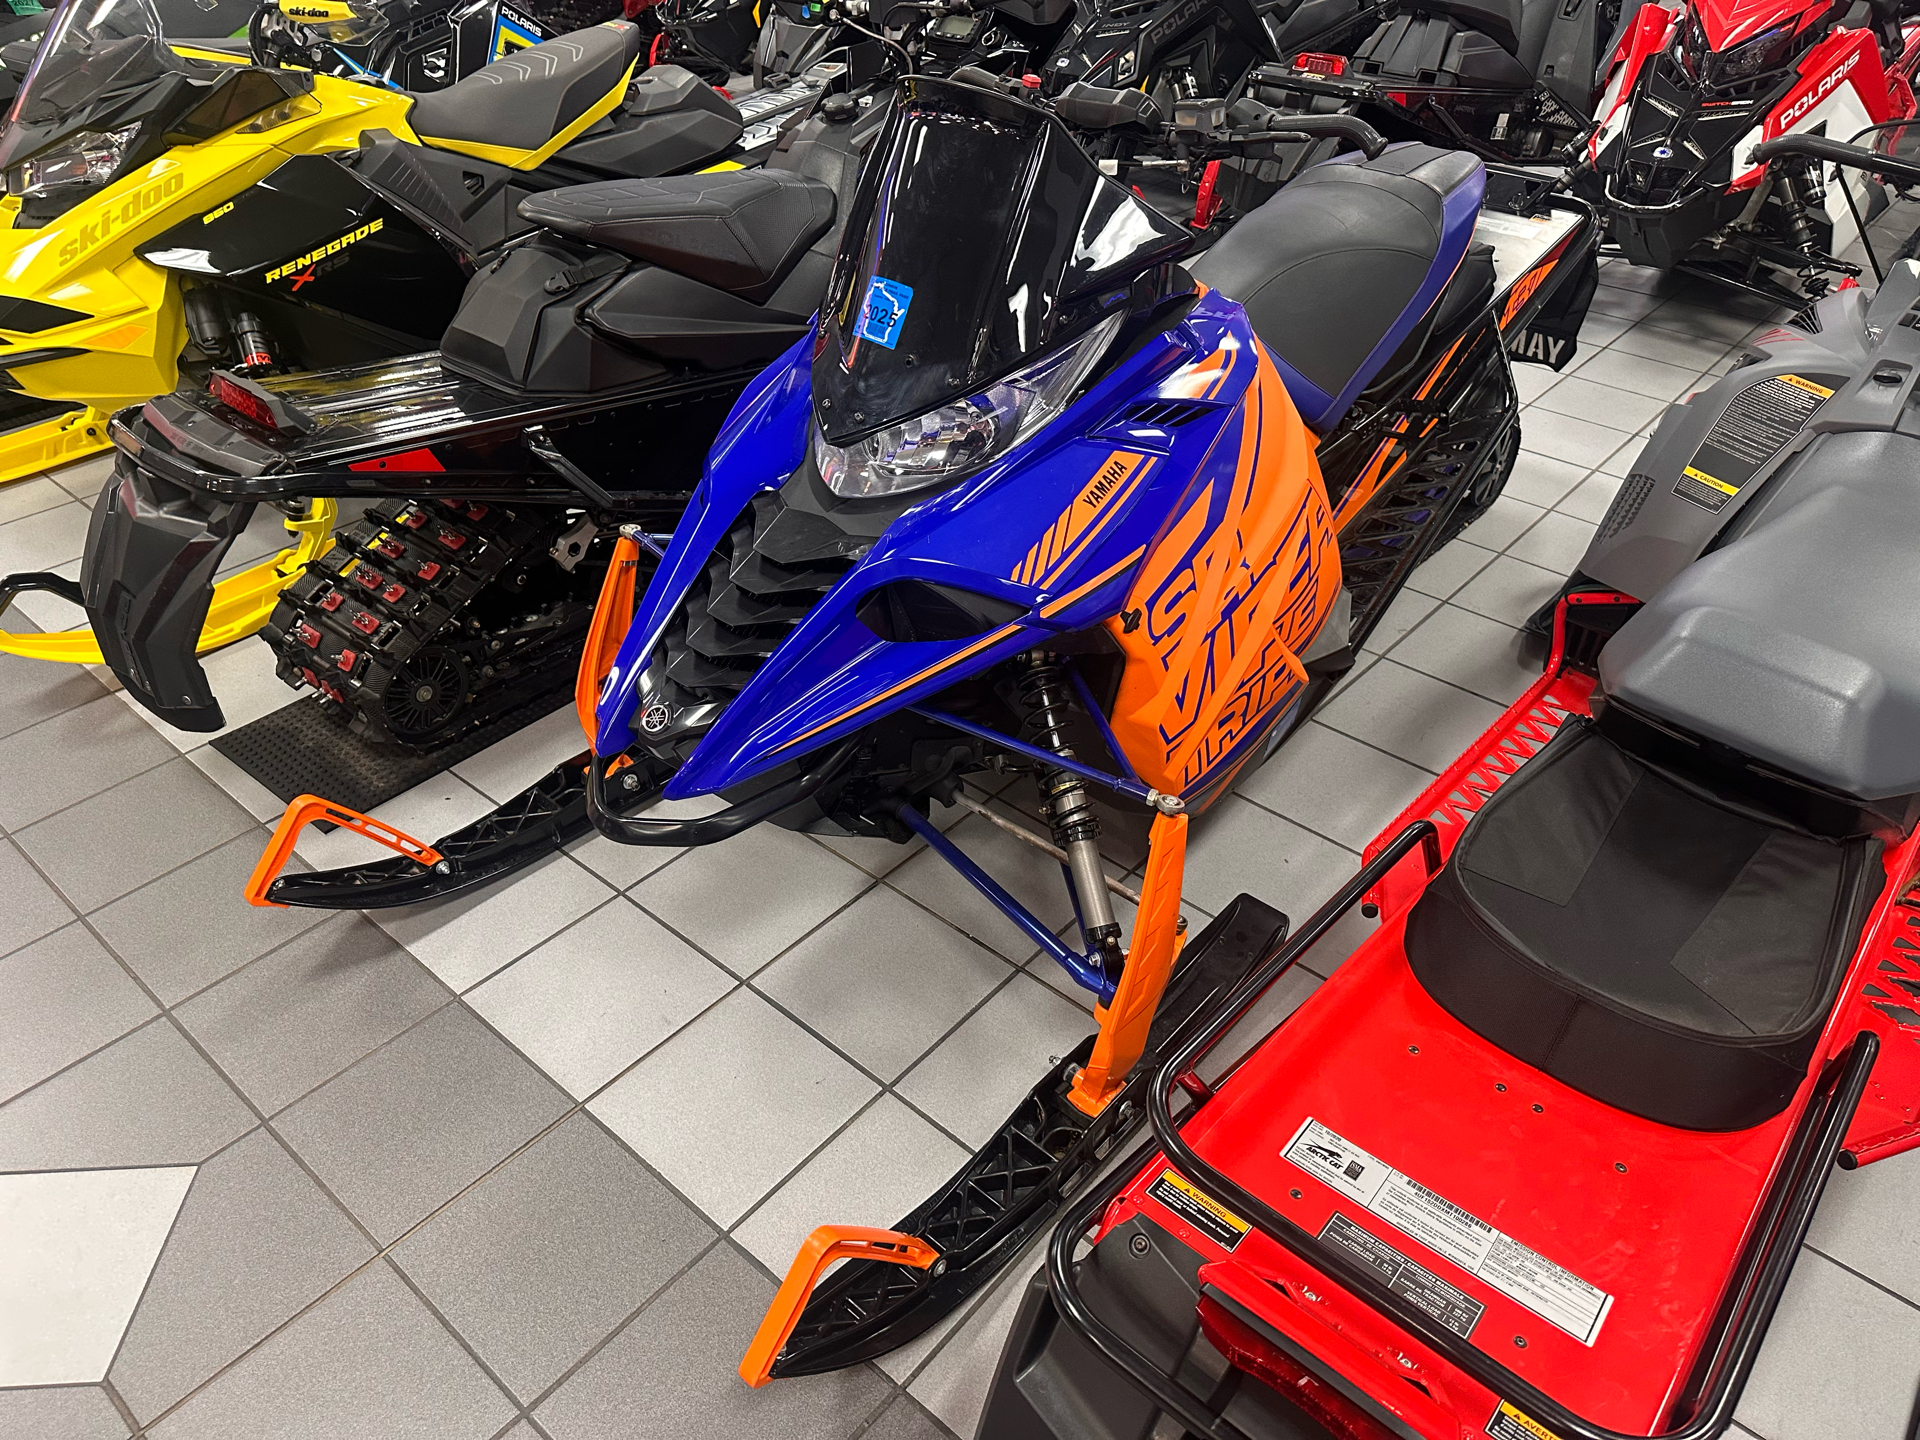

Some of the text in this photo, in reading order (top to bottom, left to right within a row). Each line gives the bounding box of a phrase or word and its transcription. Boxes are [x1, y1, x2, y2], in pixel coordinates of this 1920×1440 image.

[289, 7, 329, 18] ski-doo
[501, 6, 542, 37] POLARIS
[1151, 0, 1210, 45] POLAR
[1780, 50, 1860, 129] POLARIS
[59, 172, 183, 267] ski-doo
[264, 217, 384, 284] RENEGADE
[1795, 379, 1823, 394] WARNING
[1082, 460, 1128, 509] YAMAHA
[1699, 475, 1724, 489] CAUTION
[1306, 1146, 1328, 1162] ARCTIC
[1329, 1160, 1344, 1170] CAT
[1192, 1192, 1226, 1218] WARNING
[1351, 1226, 1375, 1244] MAXIMUM
[1375, 1241, 1404, 1262] CAPACITIES
[1511, 1240, 1594, 1291] EMISSION CONTROL INFORMATION
[1523, 1420, 1562, 1440] AVERT
